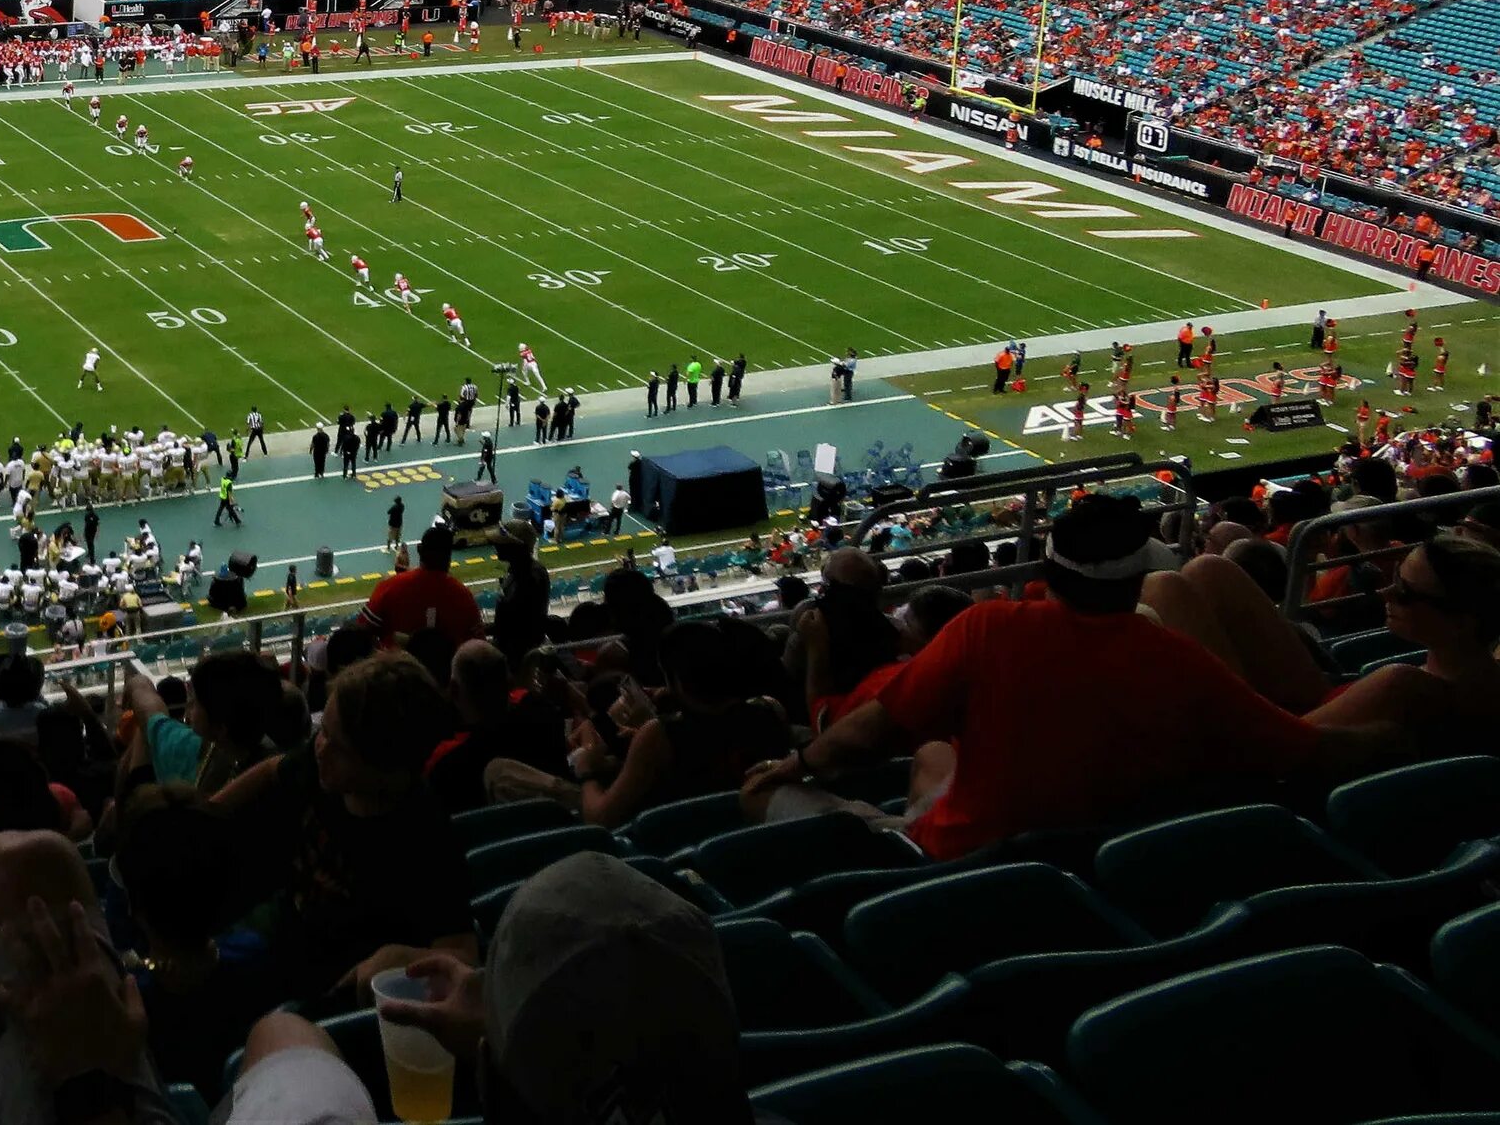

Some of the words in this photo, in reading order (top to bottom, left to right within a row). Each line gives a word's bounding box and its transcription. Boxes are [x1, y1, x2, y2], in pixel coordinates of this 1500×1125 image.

[750, 36, 813, 77] MIAMI
[1073, 76, 1124, 106] MUSCLE
[1125, 93, 1157, 114] MILK
[245, 97, 357, 117] ACC
[405, 120, 464, 135] 20
[542, 111, 596, 127] 10
[259, 131, 320, 145] 30
[699, 94, 1203, 239] MIAMI
[1073, 144, 1128, 173] ESTRELLA
[1226, 182, 1323, 237] MIAMI
[862, 236, 927, 257] 10
[698, 252, 770, 274] 20
[528, 268, 604, 291] 30
[146, 307, 228, 330] 50
[1023, 395, 1143, 435] ACC
